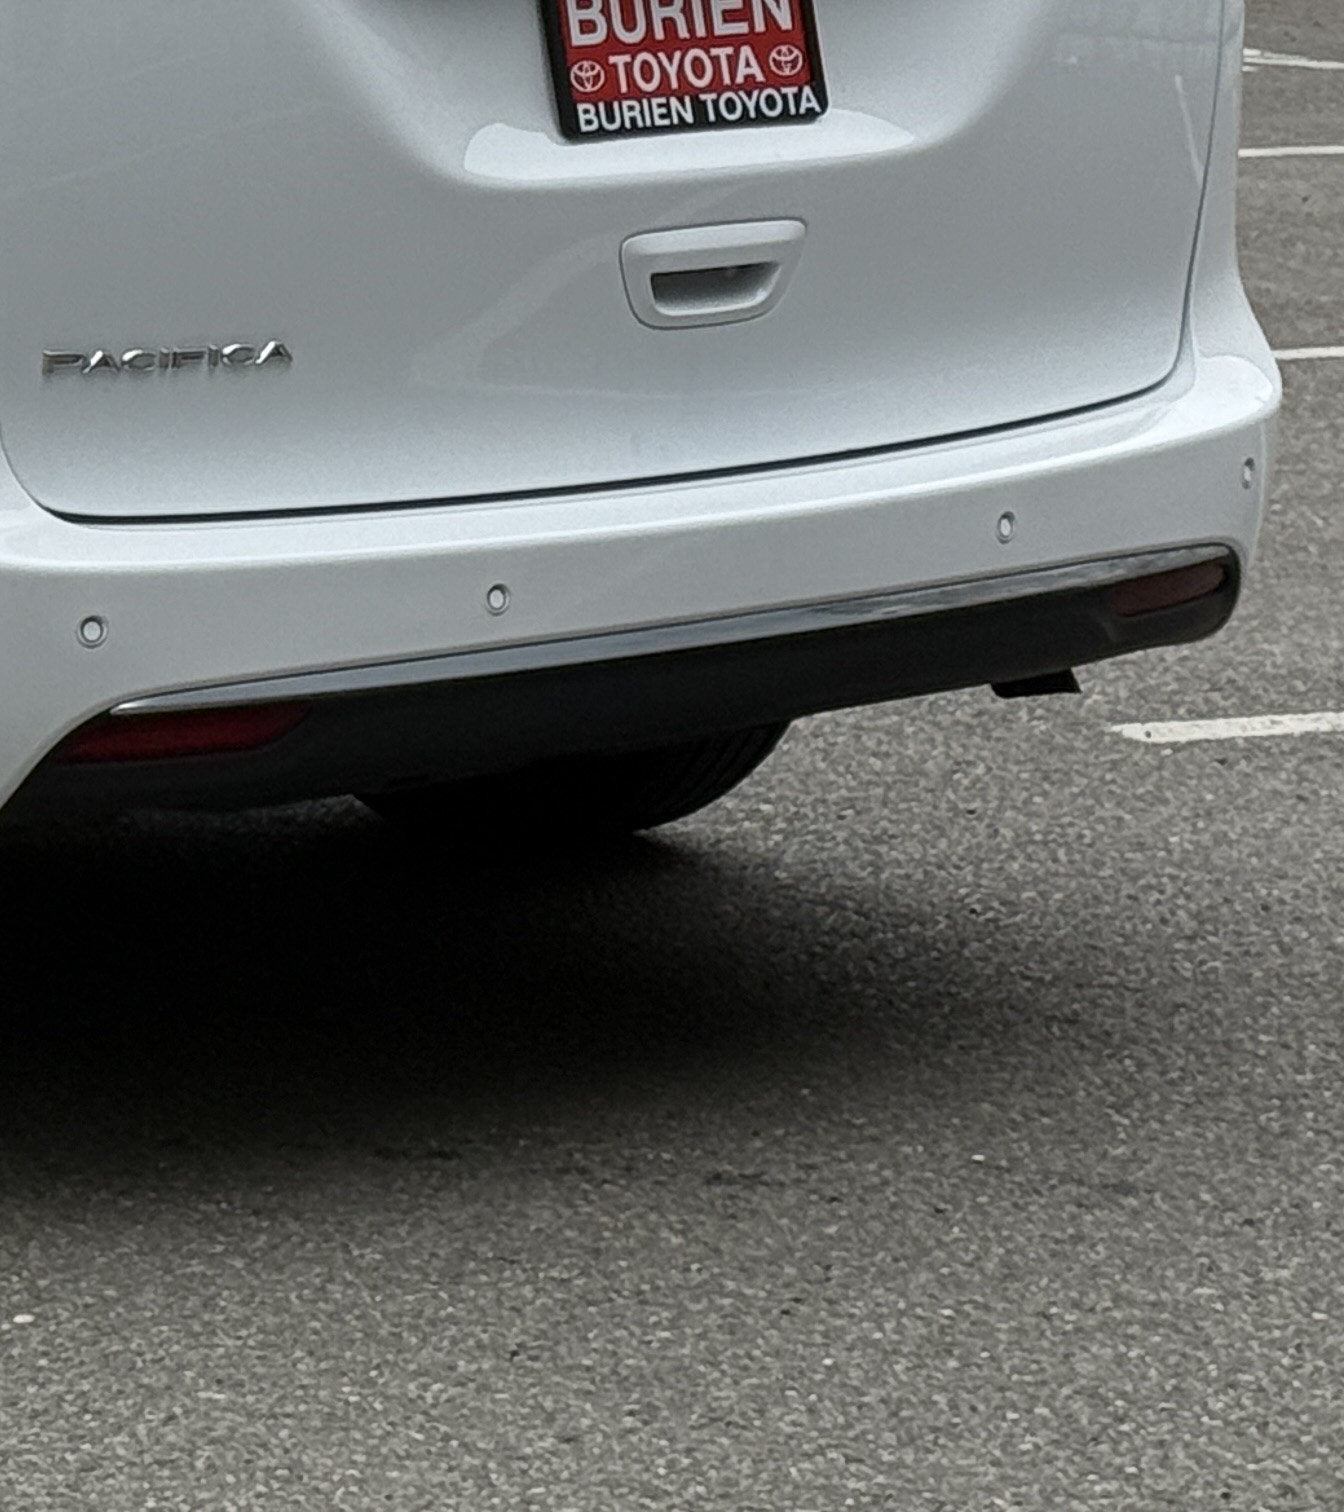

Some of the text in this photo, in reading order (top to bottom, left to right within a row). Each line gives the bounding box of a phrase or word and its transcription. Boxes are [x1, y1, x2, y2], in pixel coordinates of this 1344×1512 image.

[608, 45, 766, 94] TOYOTA
[577, 86, 823, 133] BURIEN TOYOTA
[42, 340, 293, 376] PACIFICA
